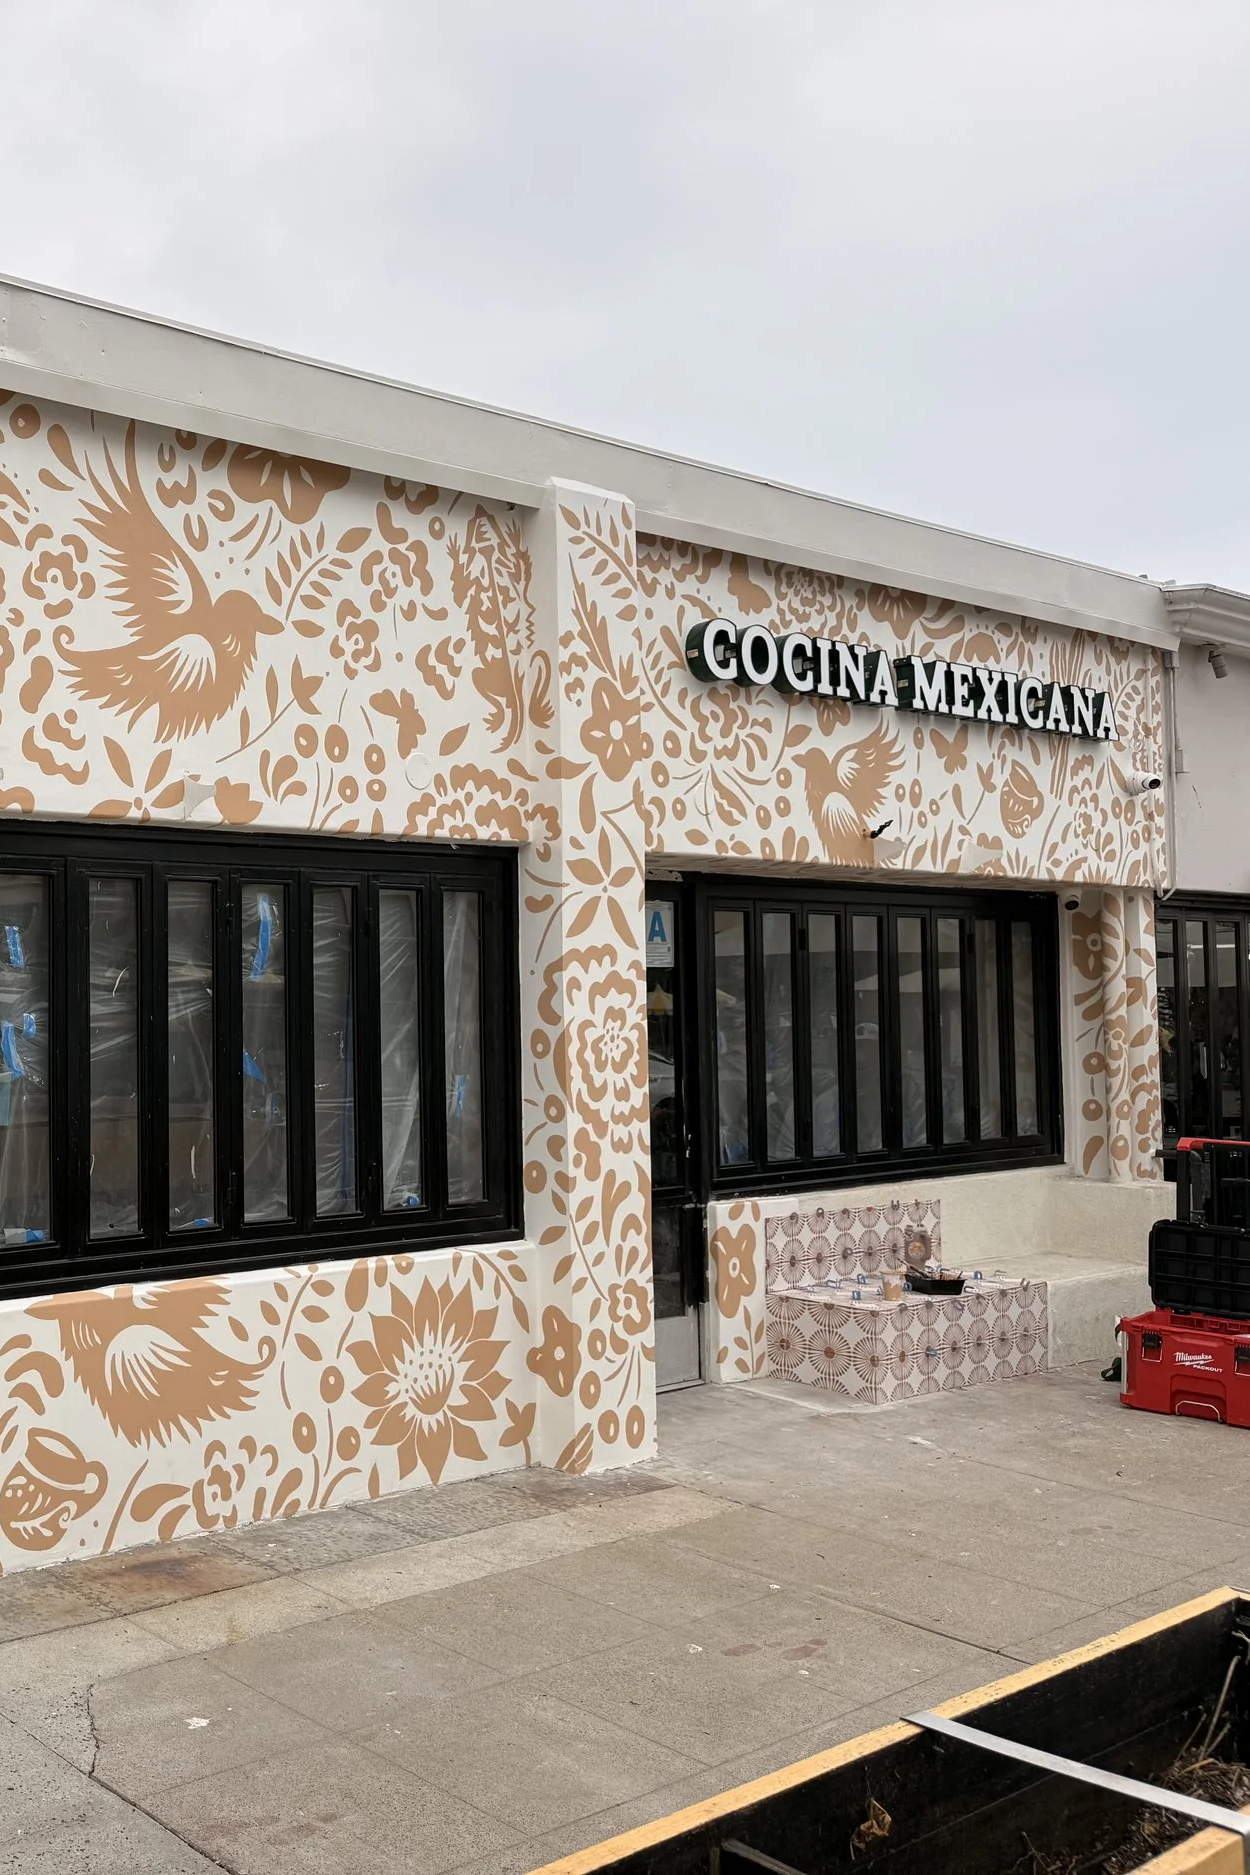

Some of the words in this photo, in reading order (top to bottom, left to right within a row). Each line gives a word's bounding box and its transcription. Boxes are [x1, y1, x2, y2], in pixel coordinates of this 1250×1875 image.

[702, 618, 898, 706] COCINA
[910, 655, 1119, 741] MEXICANA
[647, 911, 667, 942] A
[1173, 1351, 1213, 1362] Milwaukee
[1192, 1364, 1223, 1373] PACKOUT
